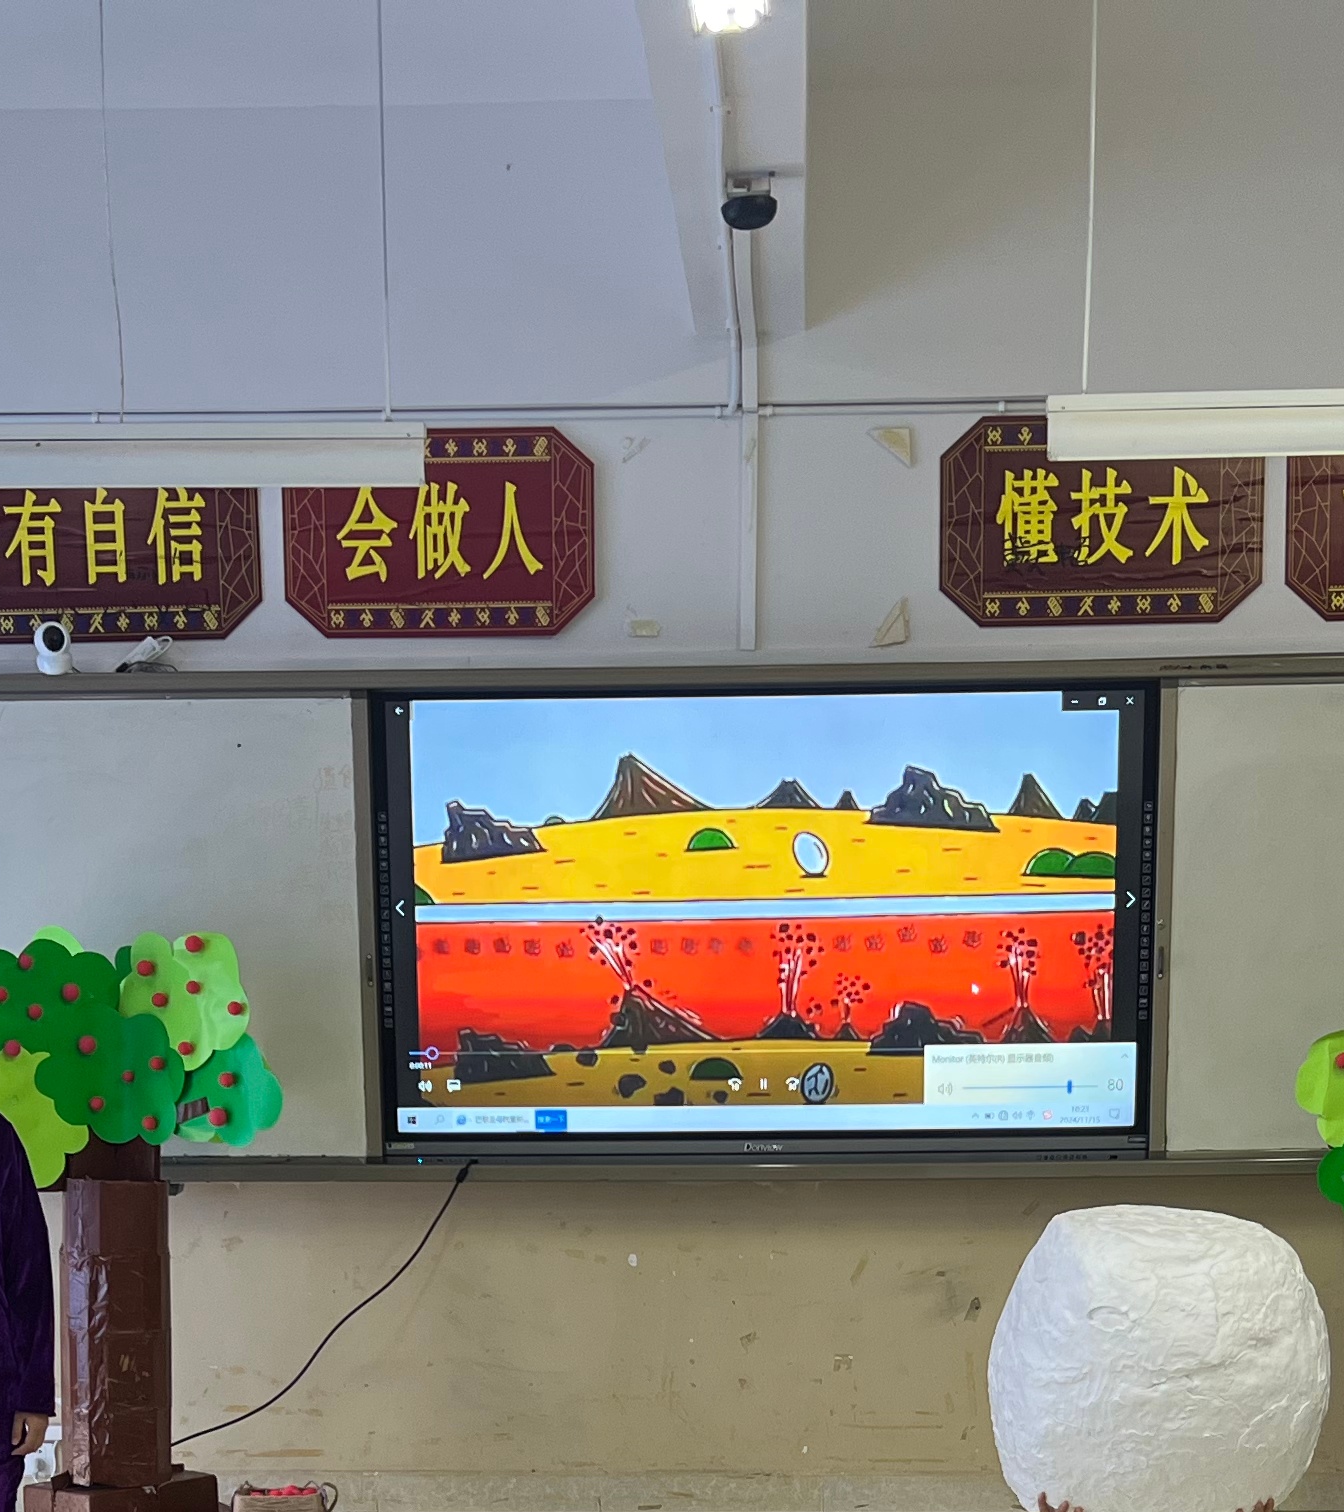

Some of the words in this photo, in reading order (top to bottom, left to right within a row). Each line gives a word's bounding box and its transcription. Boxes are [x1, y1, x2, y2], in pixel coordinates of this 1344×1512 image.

[3, 487, 207, 587] 有自信
[336, 481, 545, 583] 会做人
[996, 466, 1210, 566] 懂技术
[1107, 1078, 1124, 1091] 80
